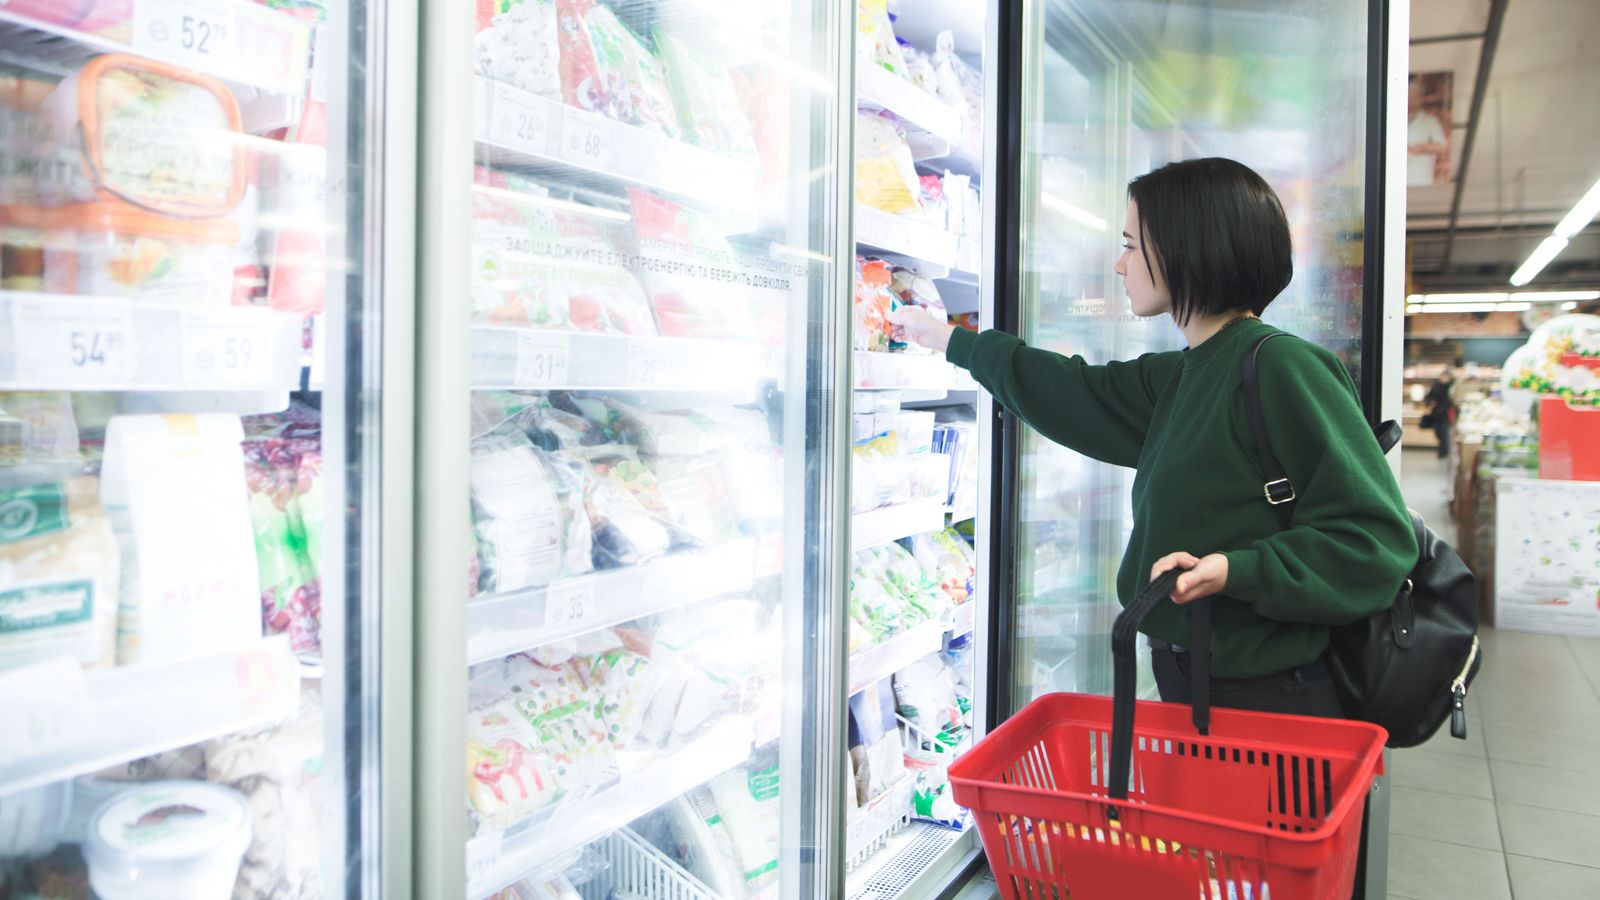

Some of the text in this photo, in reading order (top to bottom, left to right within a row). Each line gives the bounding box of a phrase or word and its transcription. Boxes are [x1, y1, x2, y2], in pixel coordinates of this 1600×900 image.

[606, 251, 696, 279] ЕЛЕКТРОЕНЕРГІЮ
[697, 265, 708, 280] ТА
[710, 267, 751, 287] БЕРЕЖІТЬ
[70, 331, 106, 368] 54
